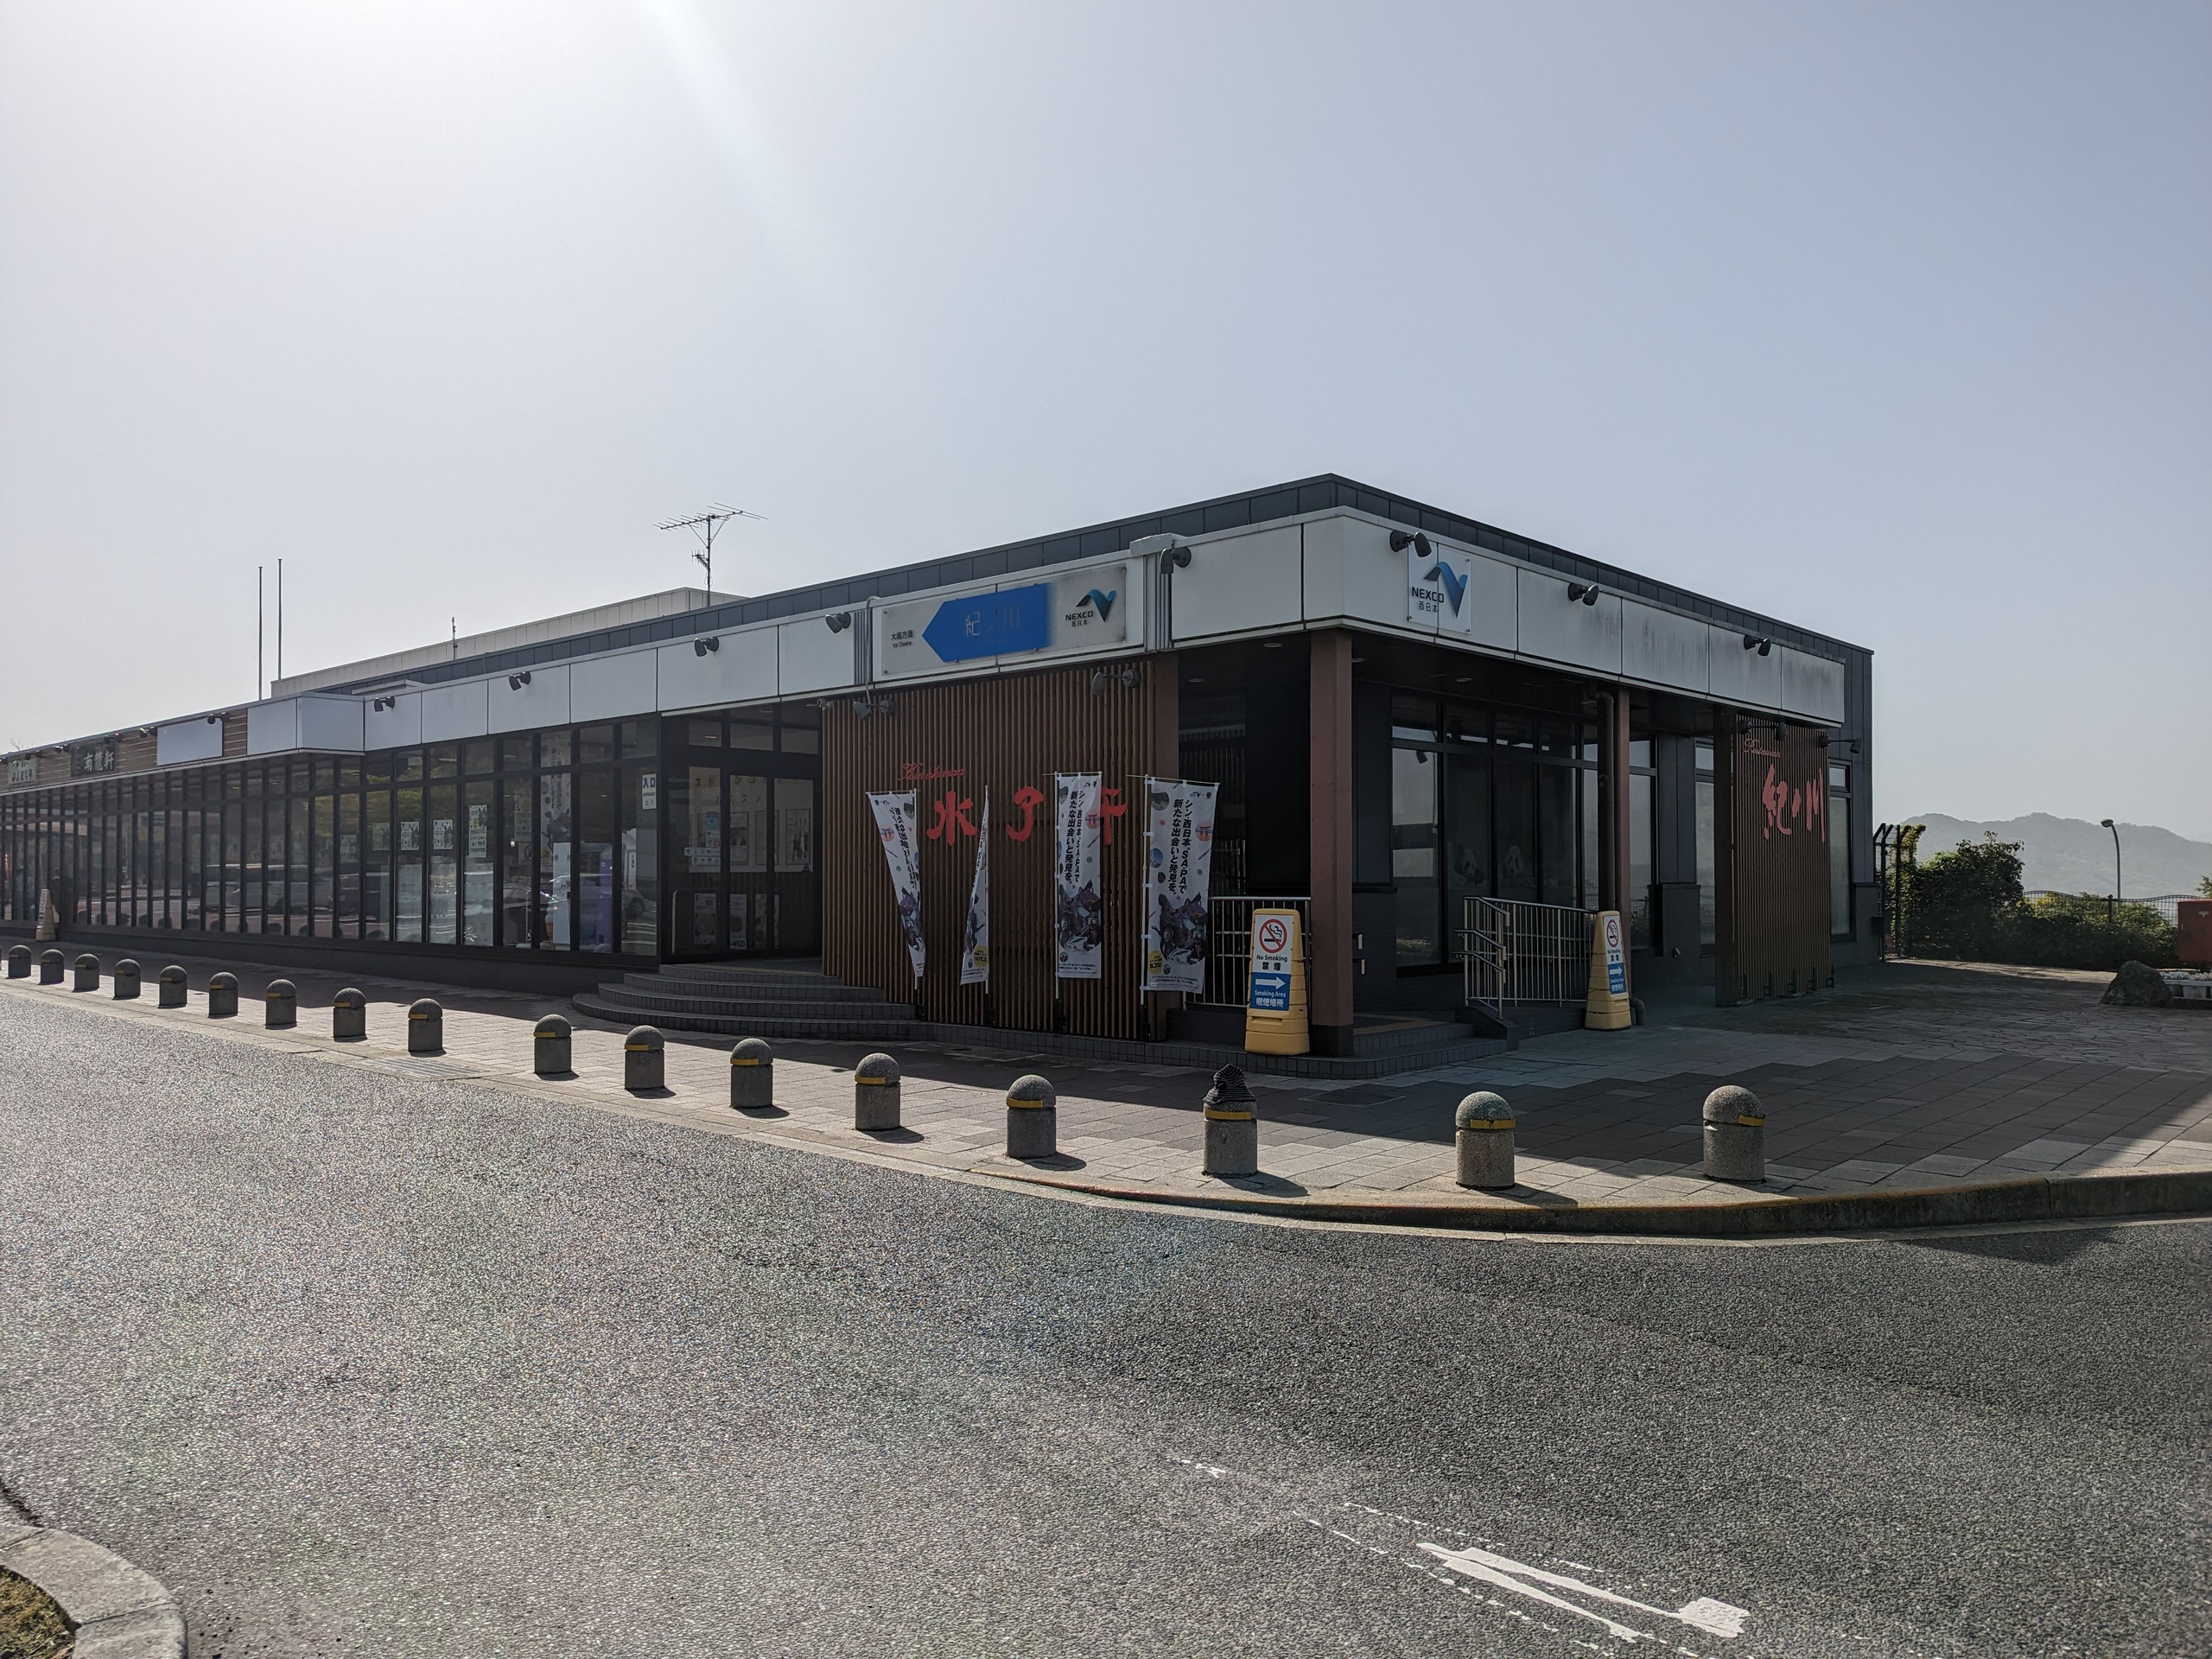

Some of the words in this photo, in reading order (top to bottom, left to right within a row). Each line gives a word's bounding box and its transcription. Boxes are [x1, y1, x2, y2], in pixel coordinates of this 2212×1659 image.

[1411, 586, 1445, 603] NEXCO
[1419, 601, 1439, 613] 西日本
[1065, 610, 1094, 621] NEXCO
[891, 629, 913, 641] 大阪方面
[643, 777, 656, 789] 入口
[1762, 763, 1825, 843] 紀ノ川
[1167, 798, 1184, 895] 新たな出会いと発見を。
[1262, 961, 1281, 971] 禁煙
[1255, 989, 1274, 998] Smoking
